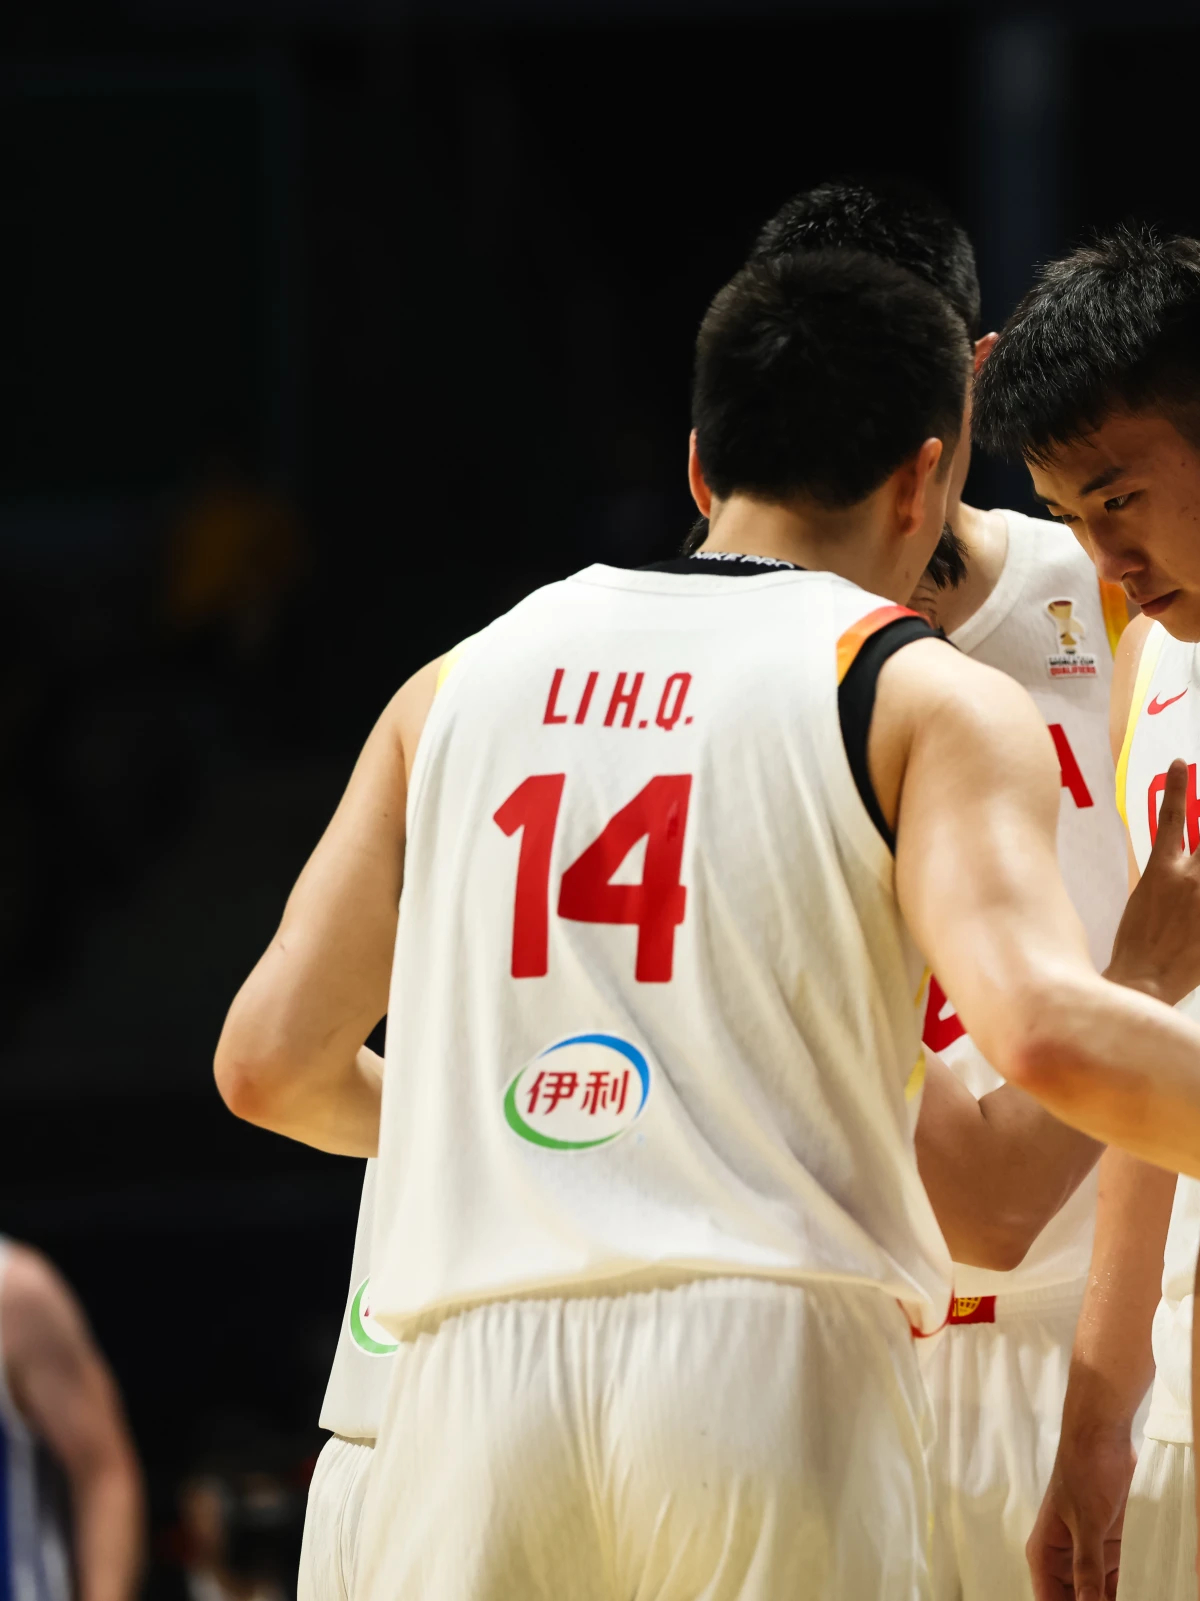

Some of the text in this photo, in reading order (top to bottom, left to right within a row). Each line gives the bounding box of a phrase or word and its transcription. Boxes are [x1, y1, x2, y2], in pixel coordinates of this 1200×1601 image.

[542, 668, 694, 732] LI H.Q.
[493, 773, 693, 983] 14
[526, 1069, 631, 1116] 伊利
